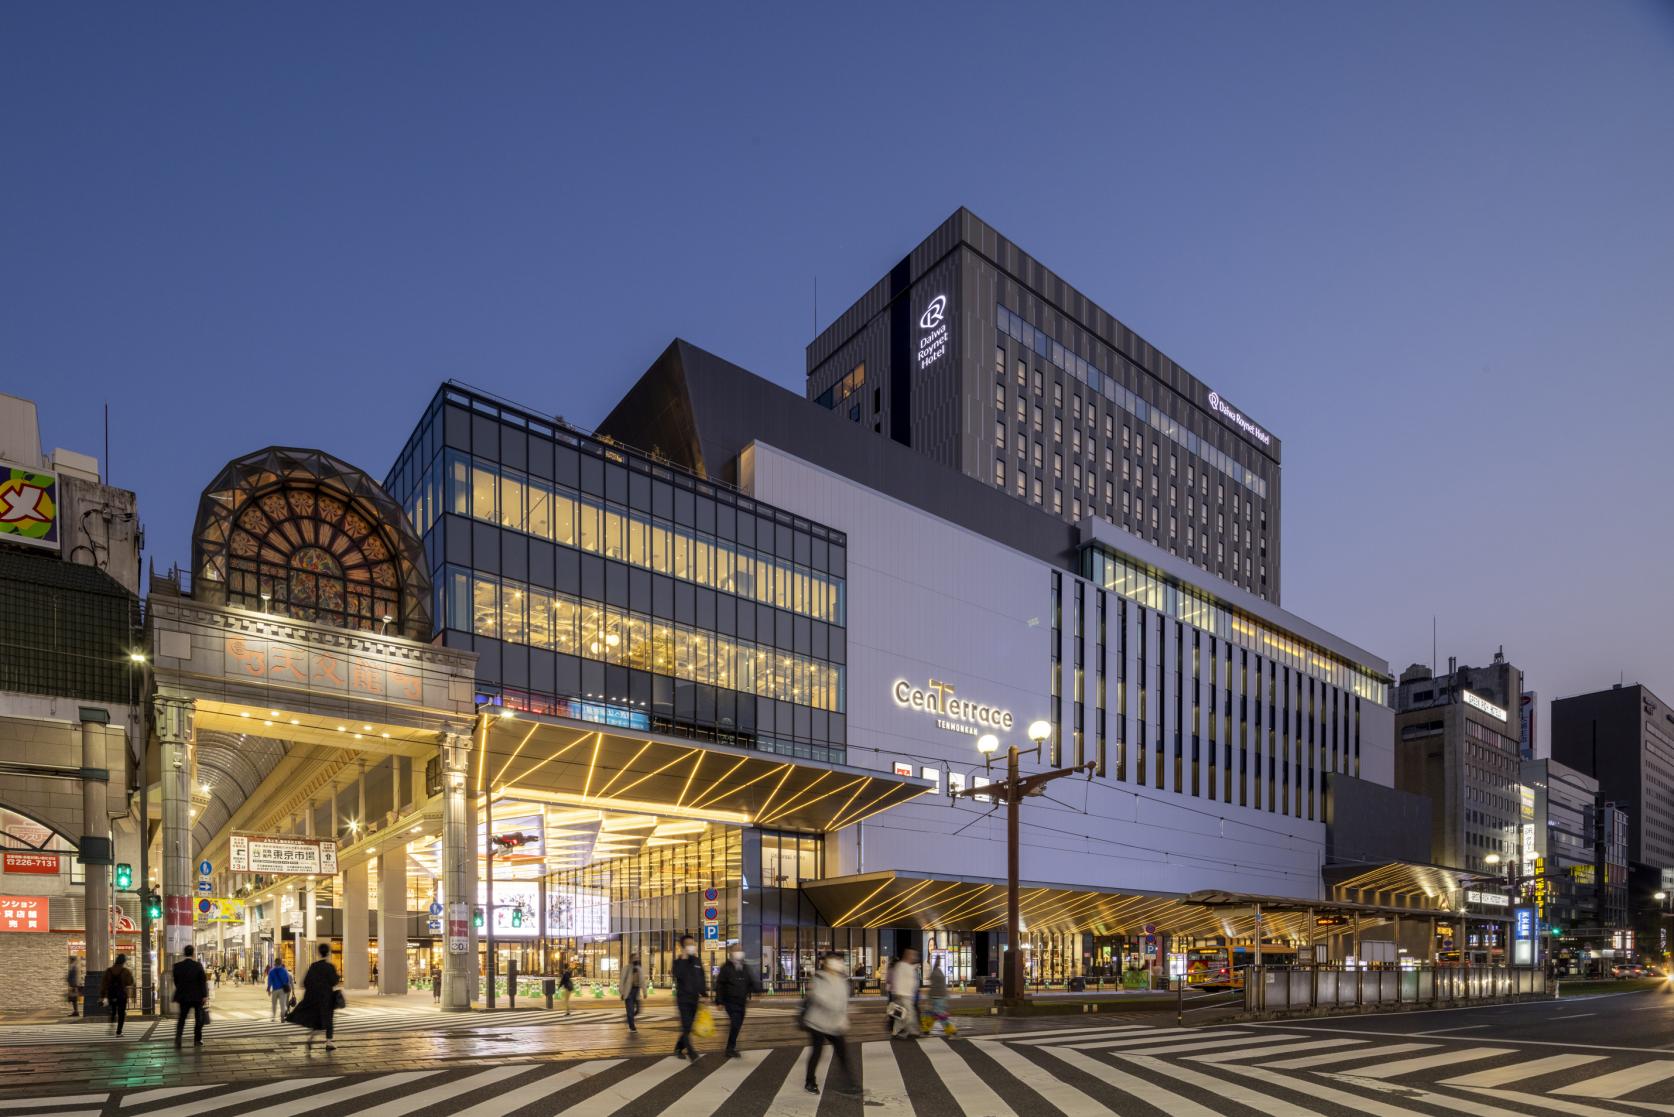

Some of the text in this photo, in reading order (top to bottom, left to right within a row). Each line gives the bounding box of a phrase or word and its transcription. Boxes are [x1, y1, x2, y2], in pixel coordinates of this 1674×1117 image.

[918, 332, 948, 361] Roynet
[920, 324, 946, 349] Daiwa
[921, 345, 945, 369] Hotel
[271, 645, 383, 694] 天文館
[894, 678, 1014, 729] CenTerrace
[15, 859, 57, 867] 226-7131
[707, 926, 716, 939] P
